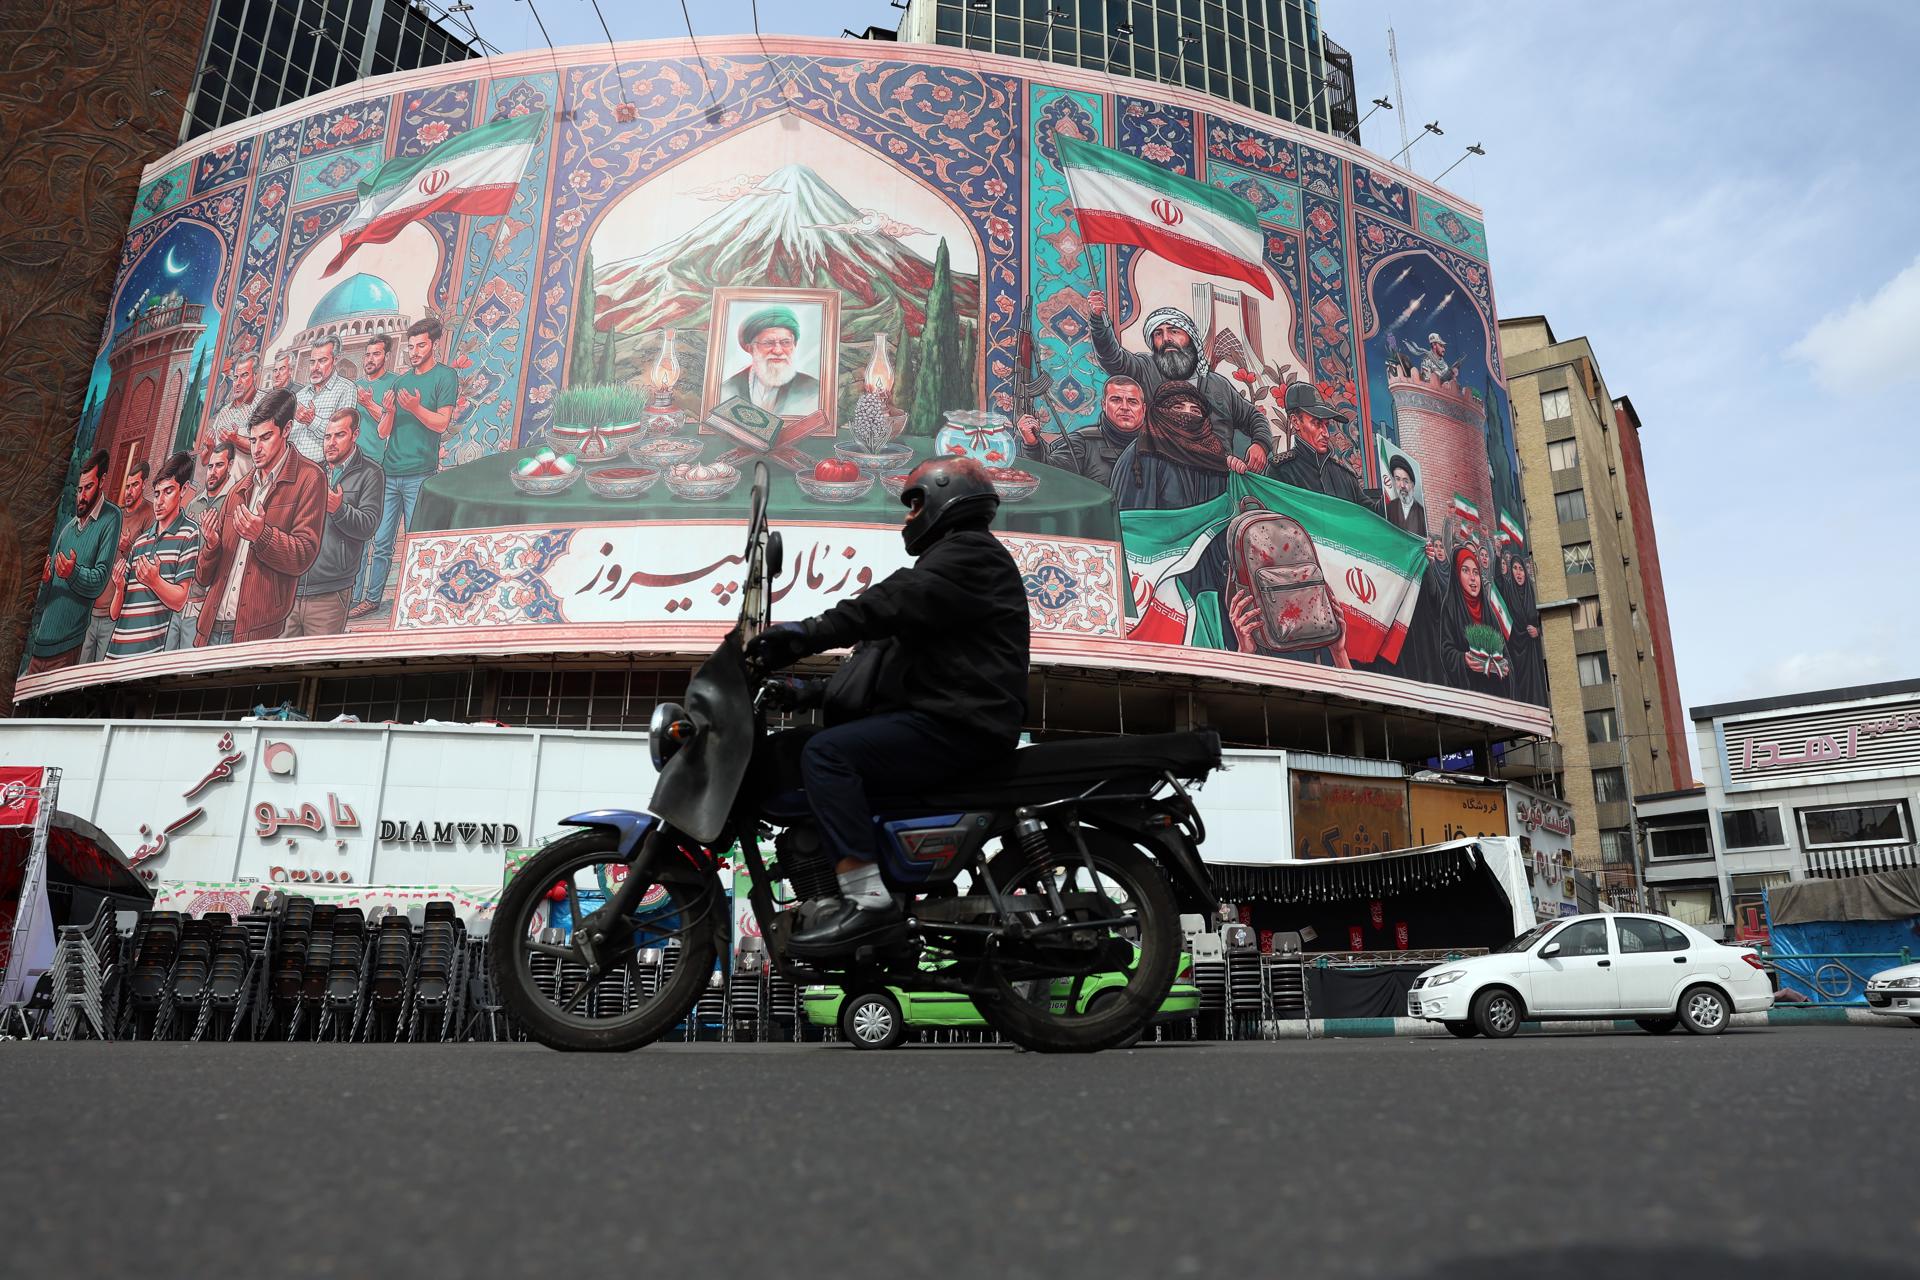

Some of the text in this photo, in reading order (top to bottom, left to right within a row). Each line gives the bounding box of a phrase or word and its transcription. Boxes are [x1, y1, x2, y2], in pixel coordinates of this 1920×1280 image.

[575, 541, 873, 613] وزمان پیروز
[182, 731, 244, 798] شهر
[1742, 726, 1858, 770] اهدا
[255, 792, 361, 847] بامبو
[1462, 798, 1498, 814] فروشگاه
